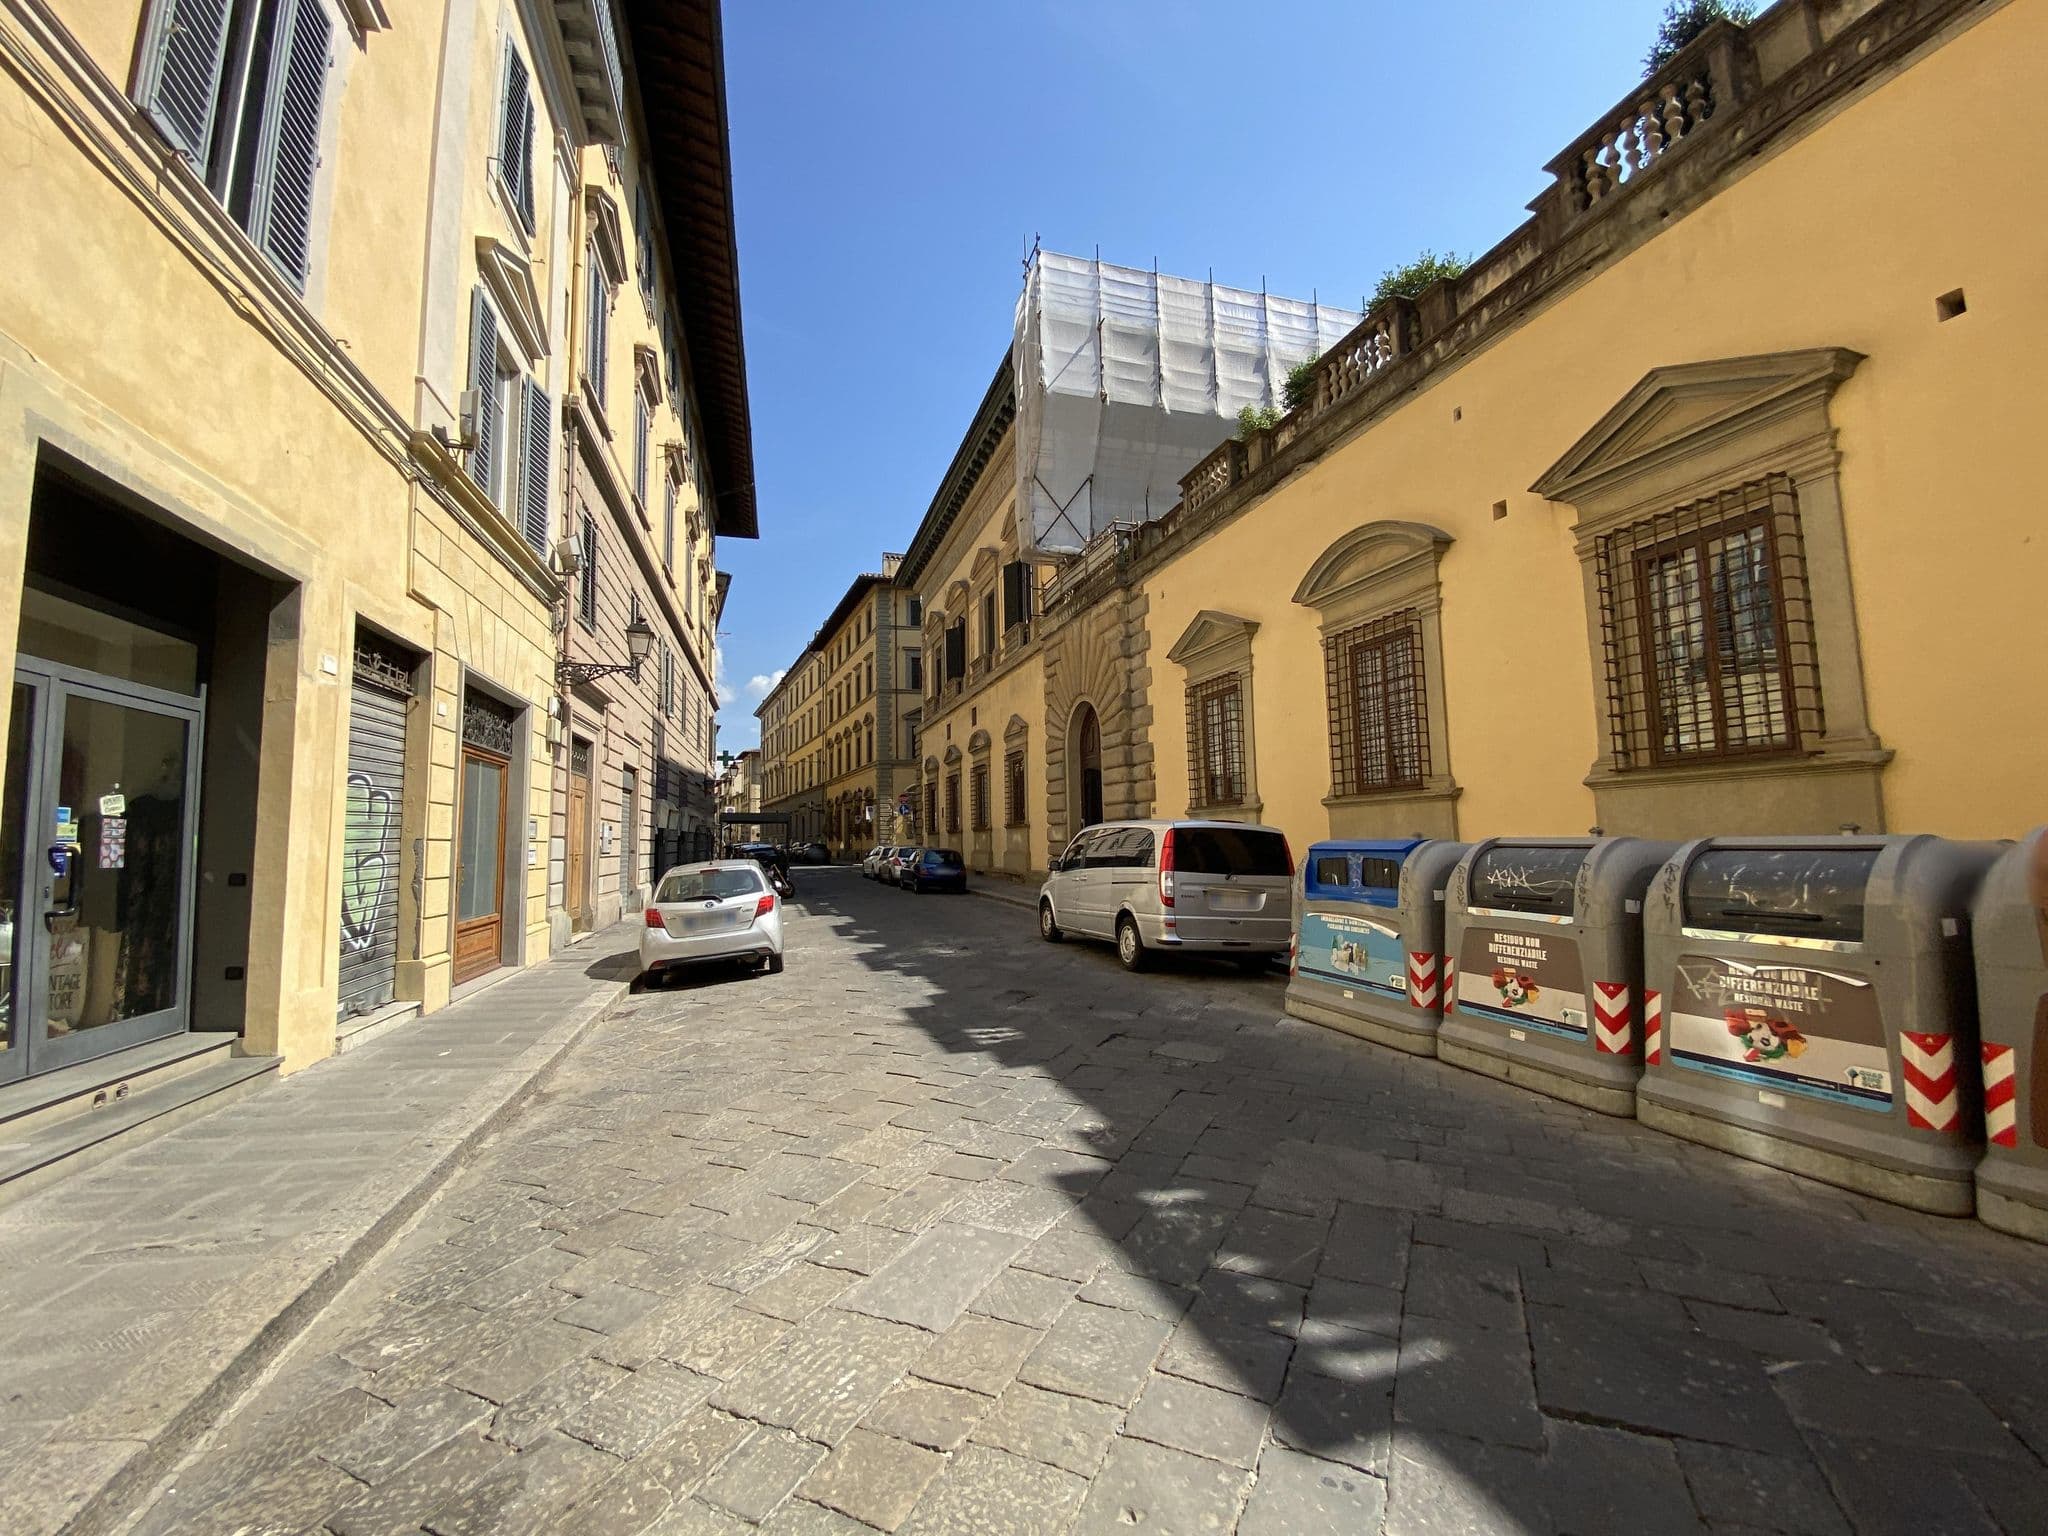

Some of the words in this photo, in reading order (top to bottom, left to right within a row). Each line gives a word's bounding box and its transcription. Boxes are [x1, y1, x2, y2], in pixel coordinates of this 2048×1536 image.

[1494, 932, 1524, 946] RESIDUO
[1488, 942, 1547, 961] DIFFERENZIABILE
[1719, 975, 1819, 1001] DIFFERENZIABILE
[1734, 993, 1773, 1008] RESIDUAL
[1775, 998, 1804, 1012] WASTE
